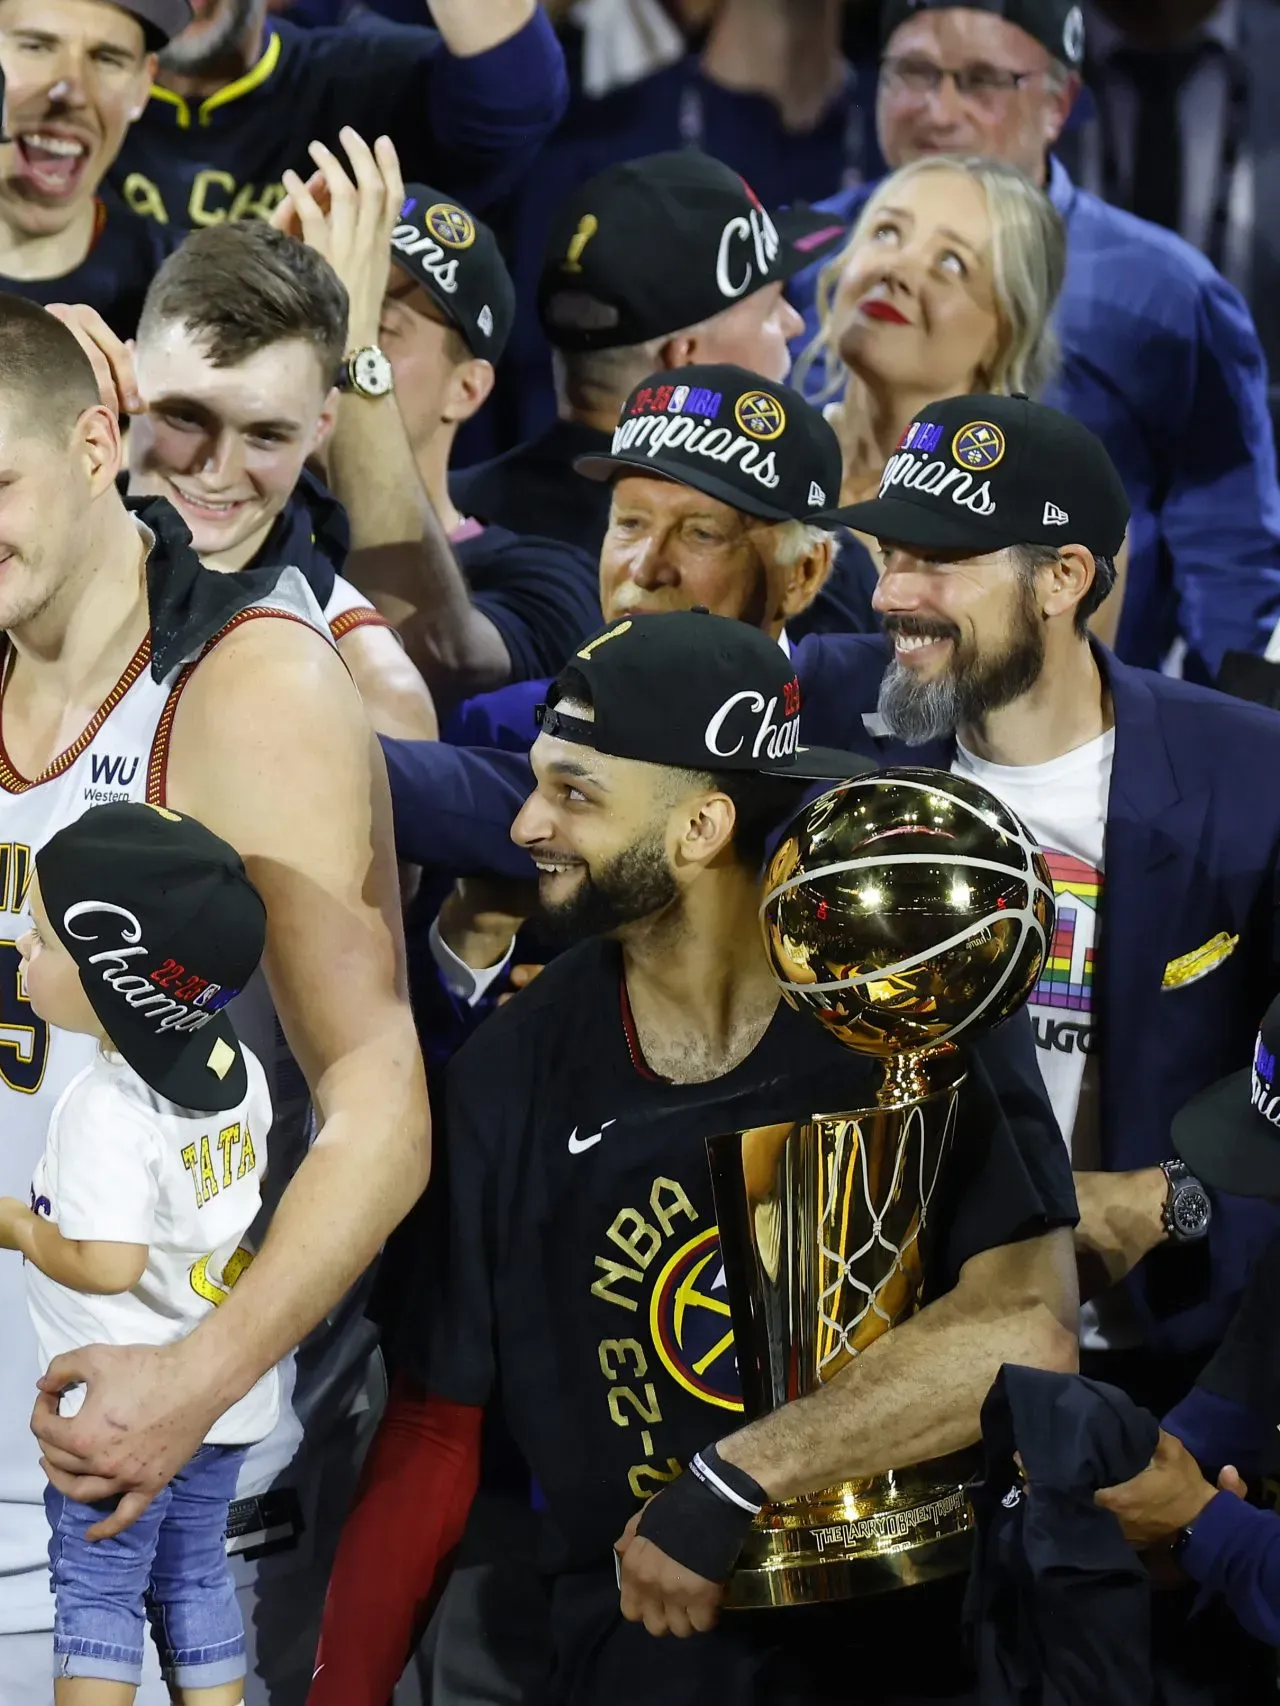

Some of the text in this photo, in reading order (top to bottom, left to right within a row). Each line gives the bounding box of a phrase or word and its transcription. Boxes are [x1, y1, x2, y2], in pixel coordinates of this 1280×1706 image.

[611, 414, 780, 489] ampions
[878, 452, 996, 516] pions
[84, 787, 130, 802] Western
[91, 754, 140, 786] WU
[63, 900, 220, 1034] Champ
[149, 958, 209, 1001] 22-23
[180, 1118, 256, 1210] TATA
[590, 1176, 700, 1312] NBA
[809, 1525, 843, 1553] THE
[841, 1515, 887, 1549] LARRY
